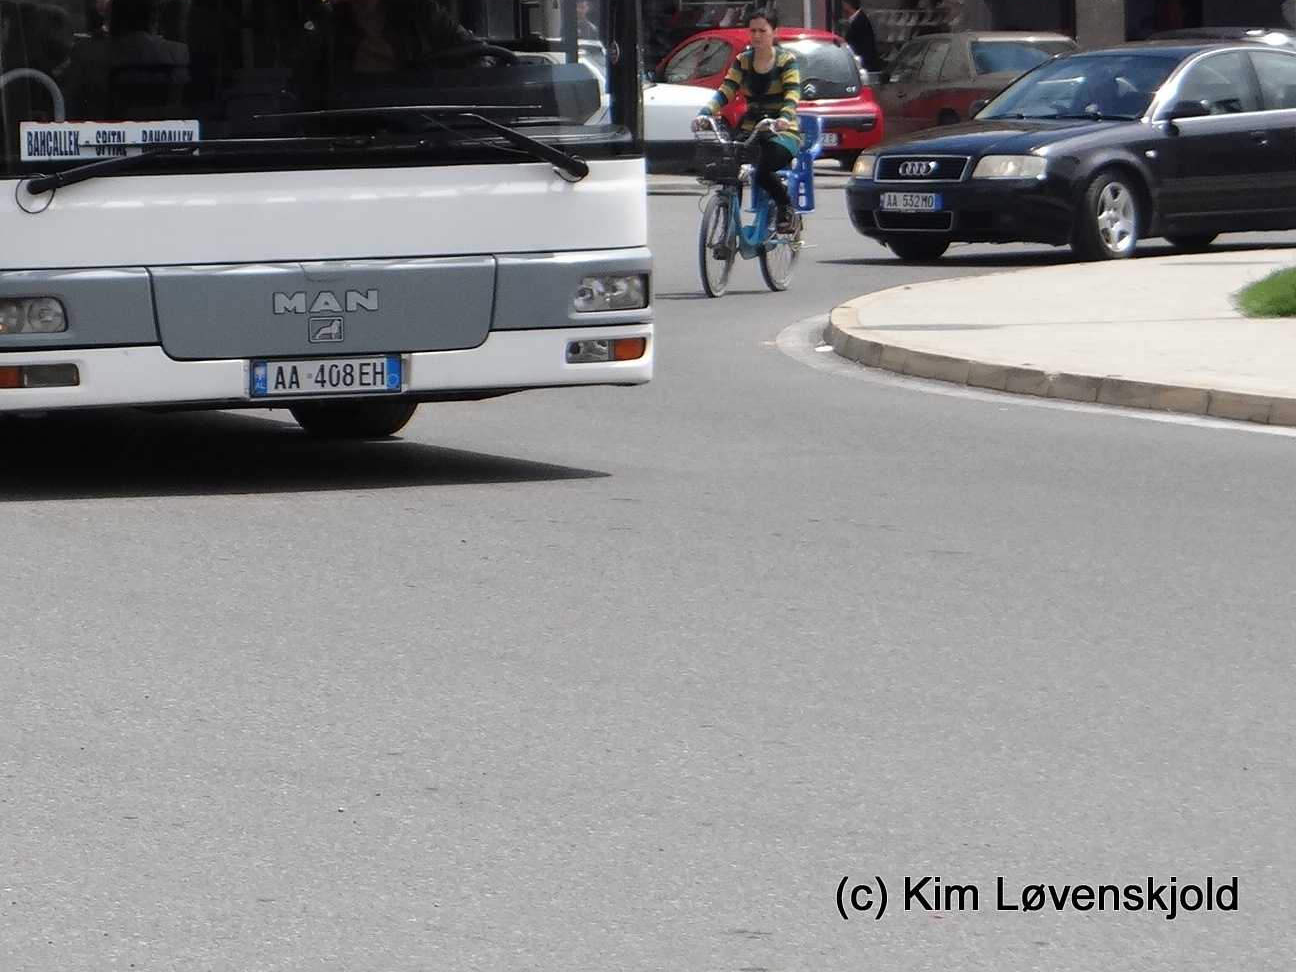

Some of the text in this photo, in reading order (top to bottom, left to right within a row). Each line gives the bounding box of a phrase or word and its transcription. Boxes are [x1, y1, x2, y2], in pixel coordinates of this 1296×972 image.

[886, 194, 898, 207] AA
[272, 289, 380, 315] MAN
[274, 366, 301, 389] AA
